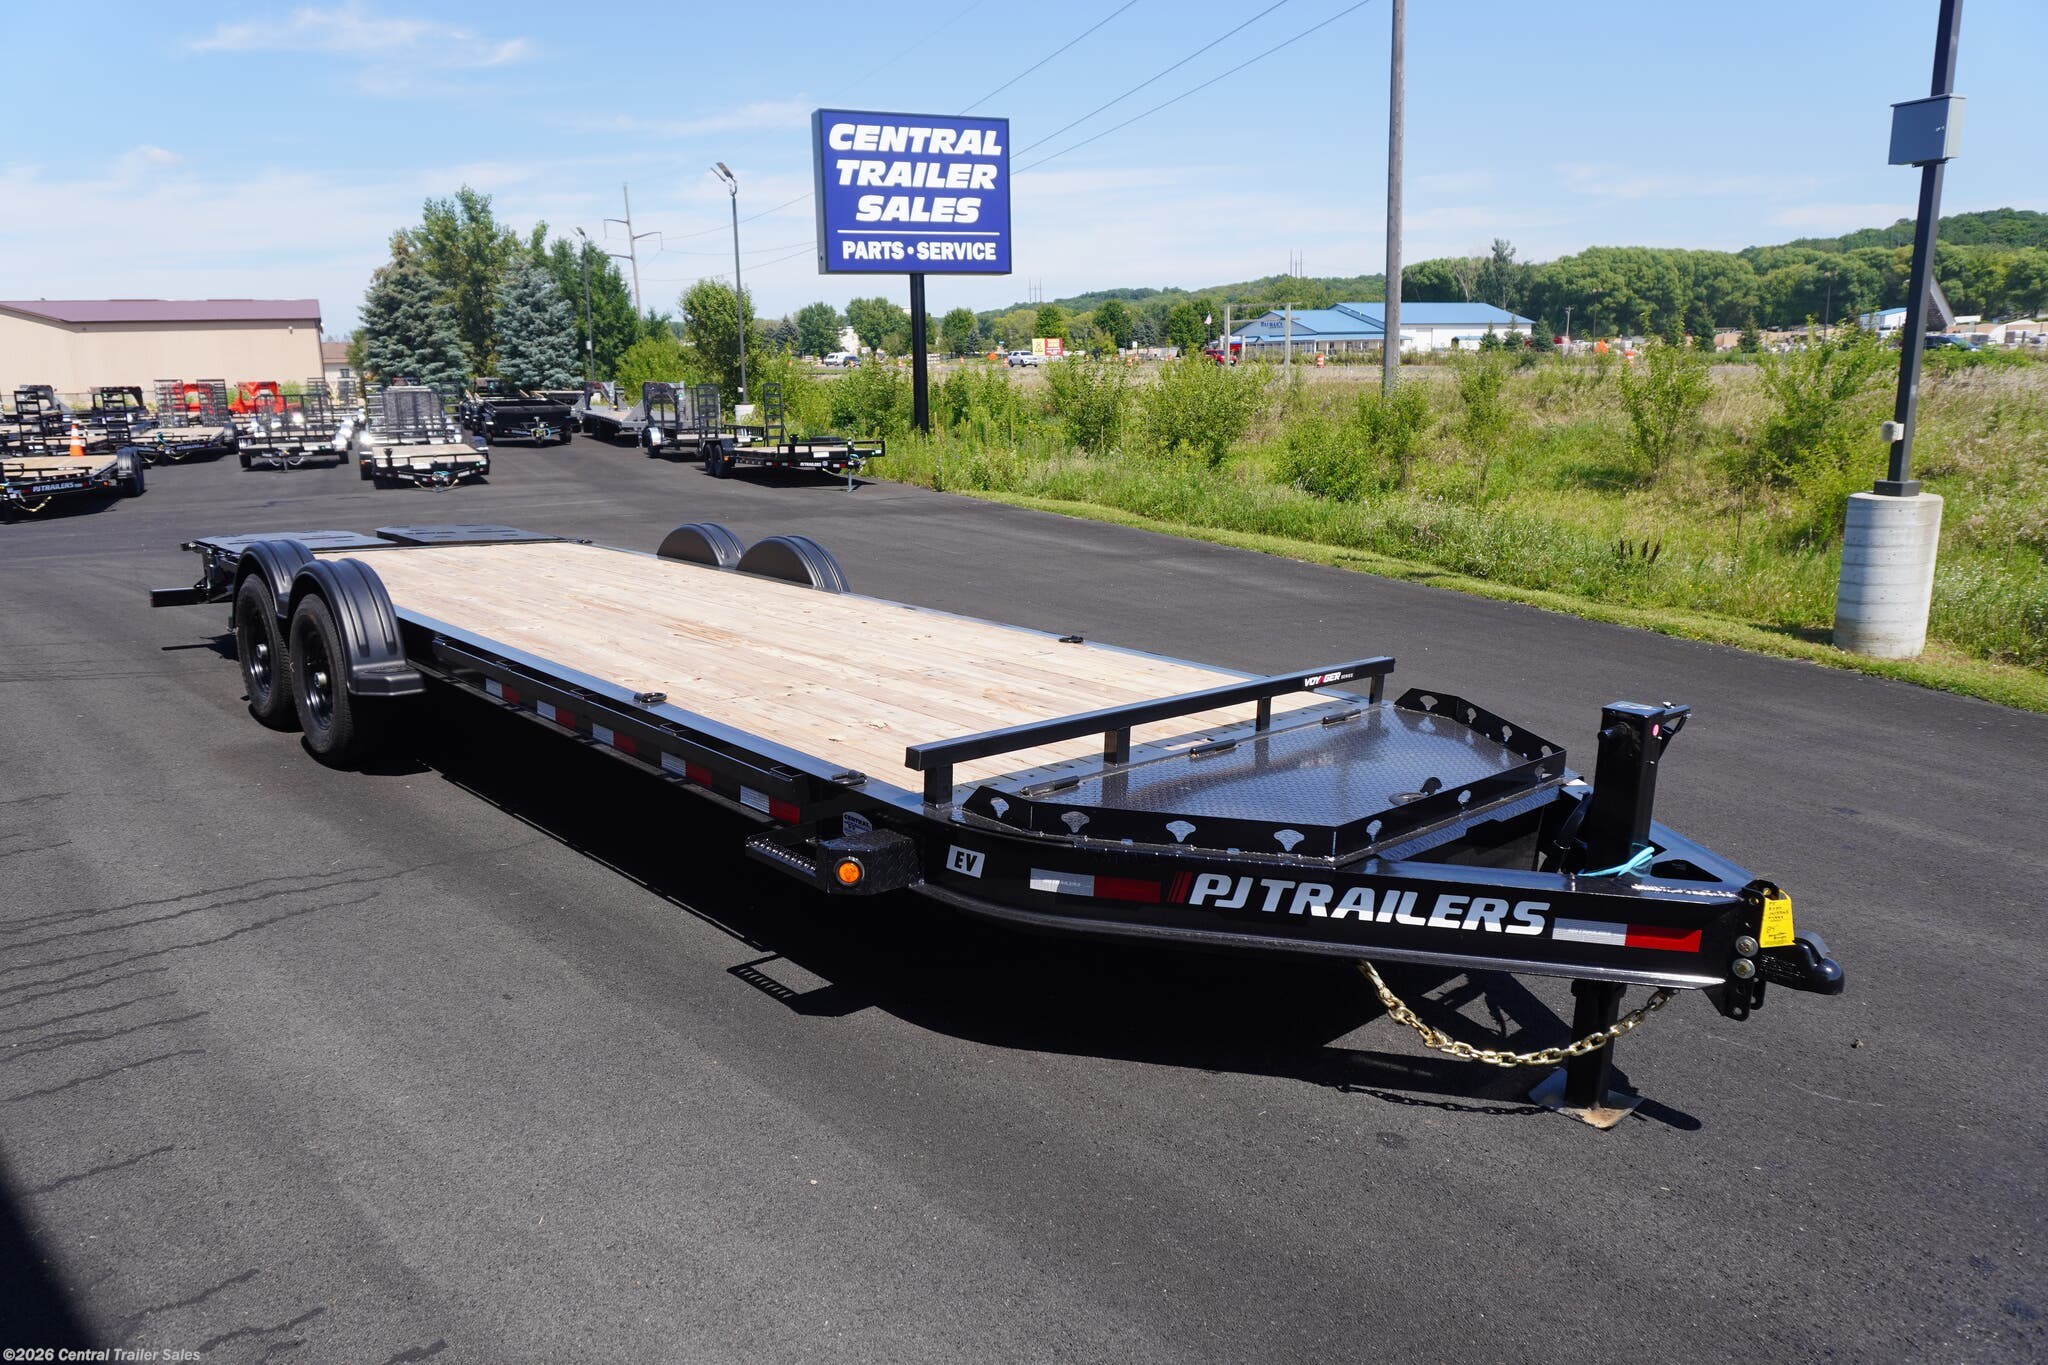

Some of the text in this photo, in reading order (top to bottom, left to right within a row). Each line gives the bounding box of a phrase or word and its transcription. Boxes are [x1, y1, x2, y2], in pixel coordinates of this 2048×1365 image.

[829, 123, 1002, 156] CENTRAL
[836, 159, 998, 189] TRAILER
[855, 195, 982, 223] SALES
[842, 241, 996, 260] PARTS SERVICE
[954, 850, 978, 872] EV
[1260, 879, 1552, 936] TRAILERS
